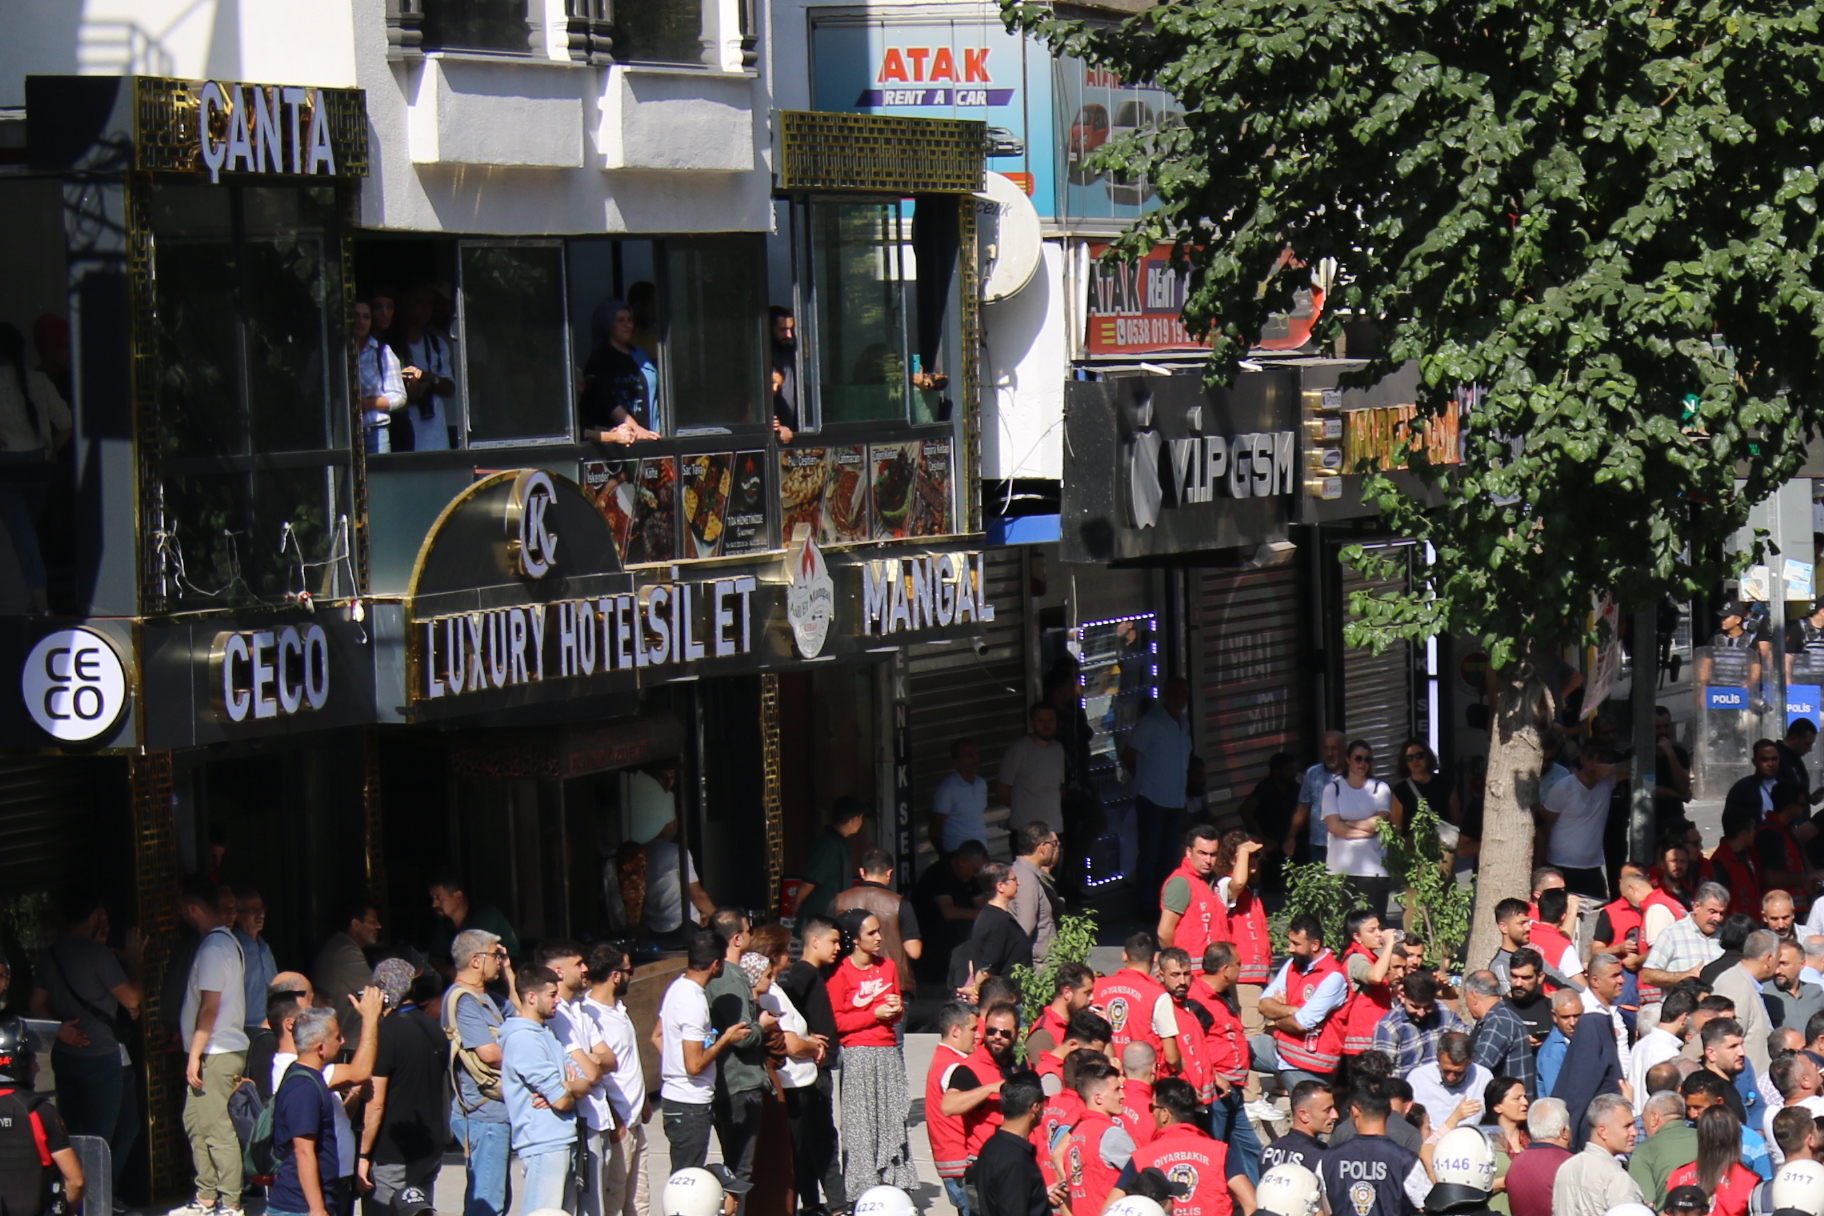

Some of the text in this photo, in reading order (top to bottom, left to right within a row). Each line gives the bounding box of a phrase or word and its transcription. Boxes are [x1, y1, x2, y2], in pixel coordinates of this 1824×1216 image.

[877, 47, 992, 83] ATAK
[884, 90, 987, 106] RENT A CAR
[199, 81, 335, 183] ÇANTA
[1088, 258, 1175, 316] ATAK RENT
[1126, 318, 1149, 345] 0538
[1152, 318, 1170, 343] 019
[1228, 432, 1293, 499] GSM
[714, 573, 757, 658] ET
[862, 548, 995, 638] MANGAL
[44, 647, 101, 682] CE
[429, 604, 545, 698] LUXURY
[222, 622, 329, 722] CECO
[44, 686, 103, 720] CO
[1712, 694, 1741, 704] POLİS
[1786, 703, 1811, 714] POLİS
[858, 978, 884, 996] NIKE
[1153, 1152, 1210, 1168] DİYARBAKIR
[1477, 1162, 1491, 1175] 73
[669, 1175, 697, 1187] 4221
[1782, 1171, 1814, 1185] 3117
